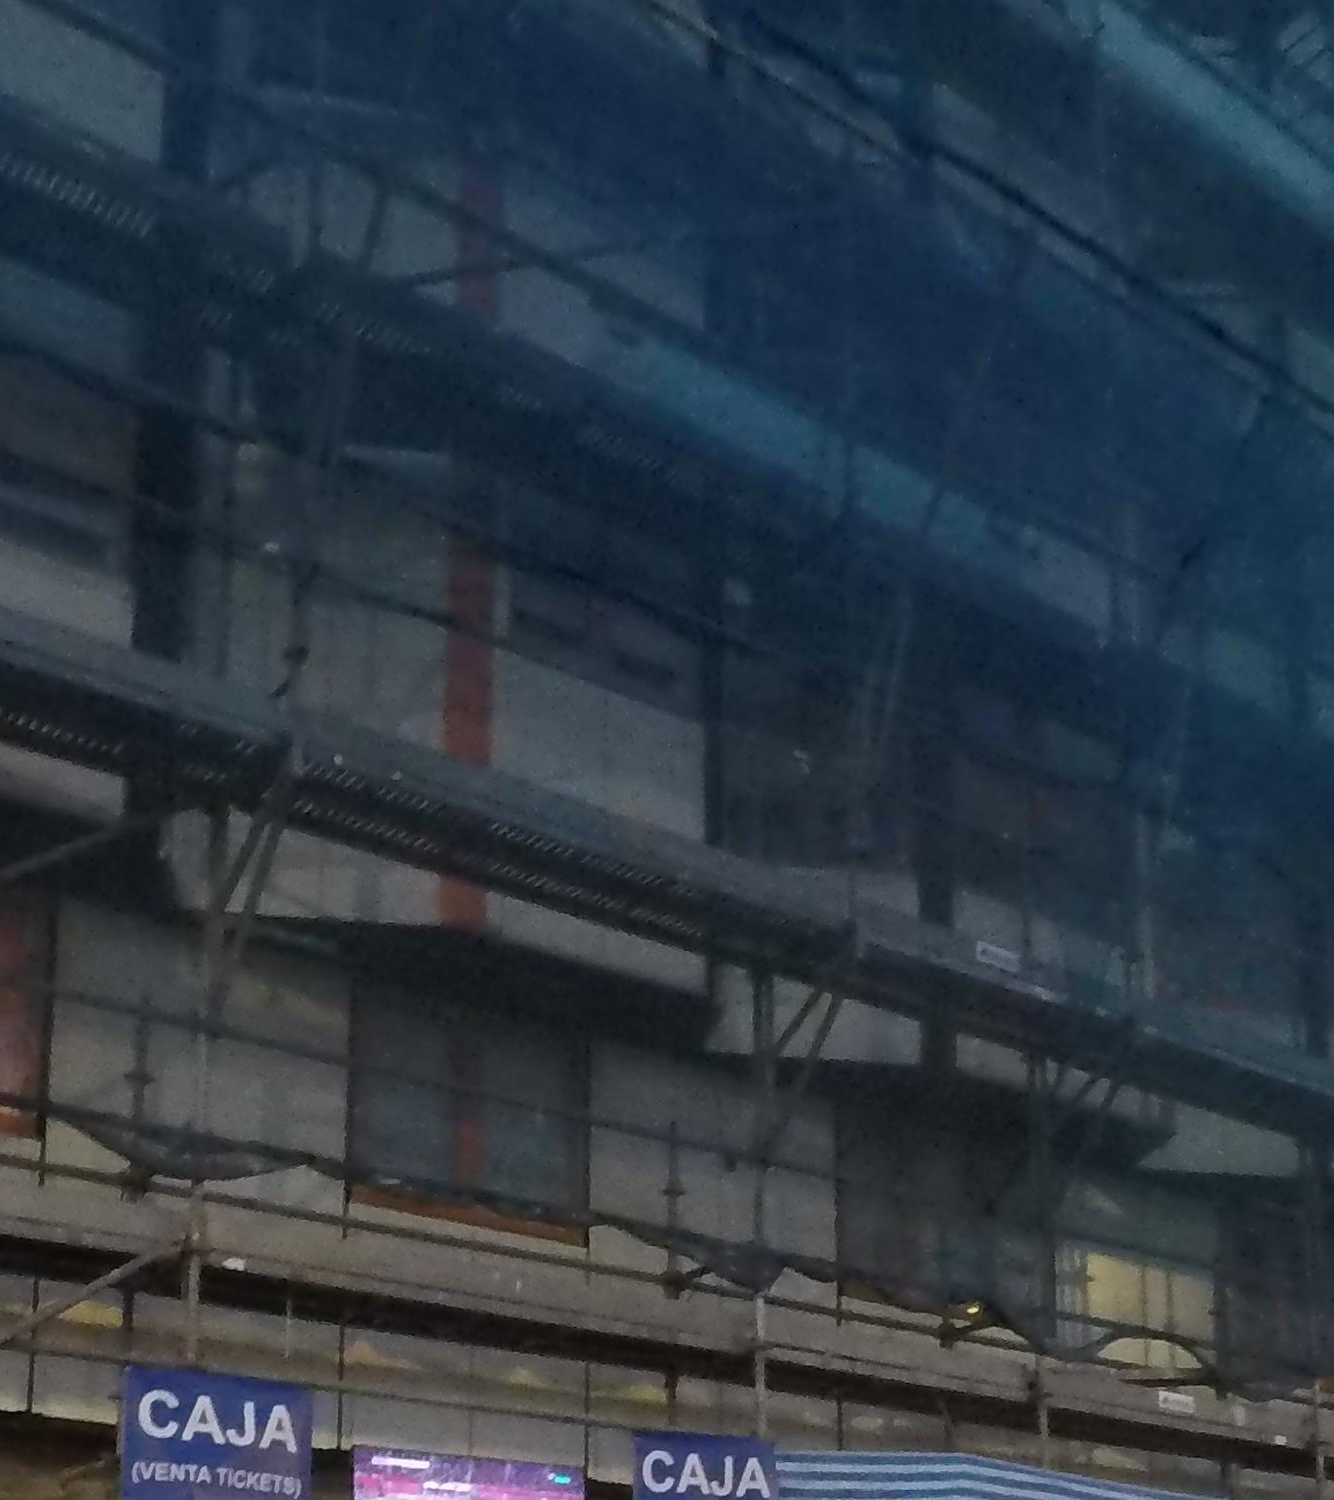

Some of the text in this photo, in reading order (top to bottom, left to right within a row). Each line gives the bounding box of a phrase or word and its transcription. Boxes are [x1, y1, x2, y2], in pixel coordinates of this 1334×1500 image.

[138, 1389, 298, 1454] CAJA
[131, 1461, 303, 1500] (VENTA TICKETS)
[642, 1450, 771, 1499] CAJA
